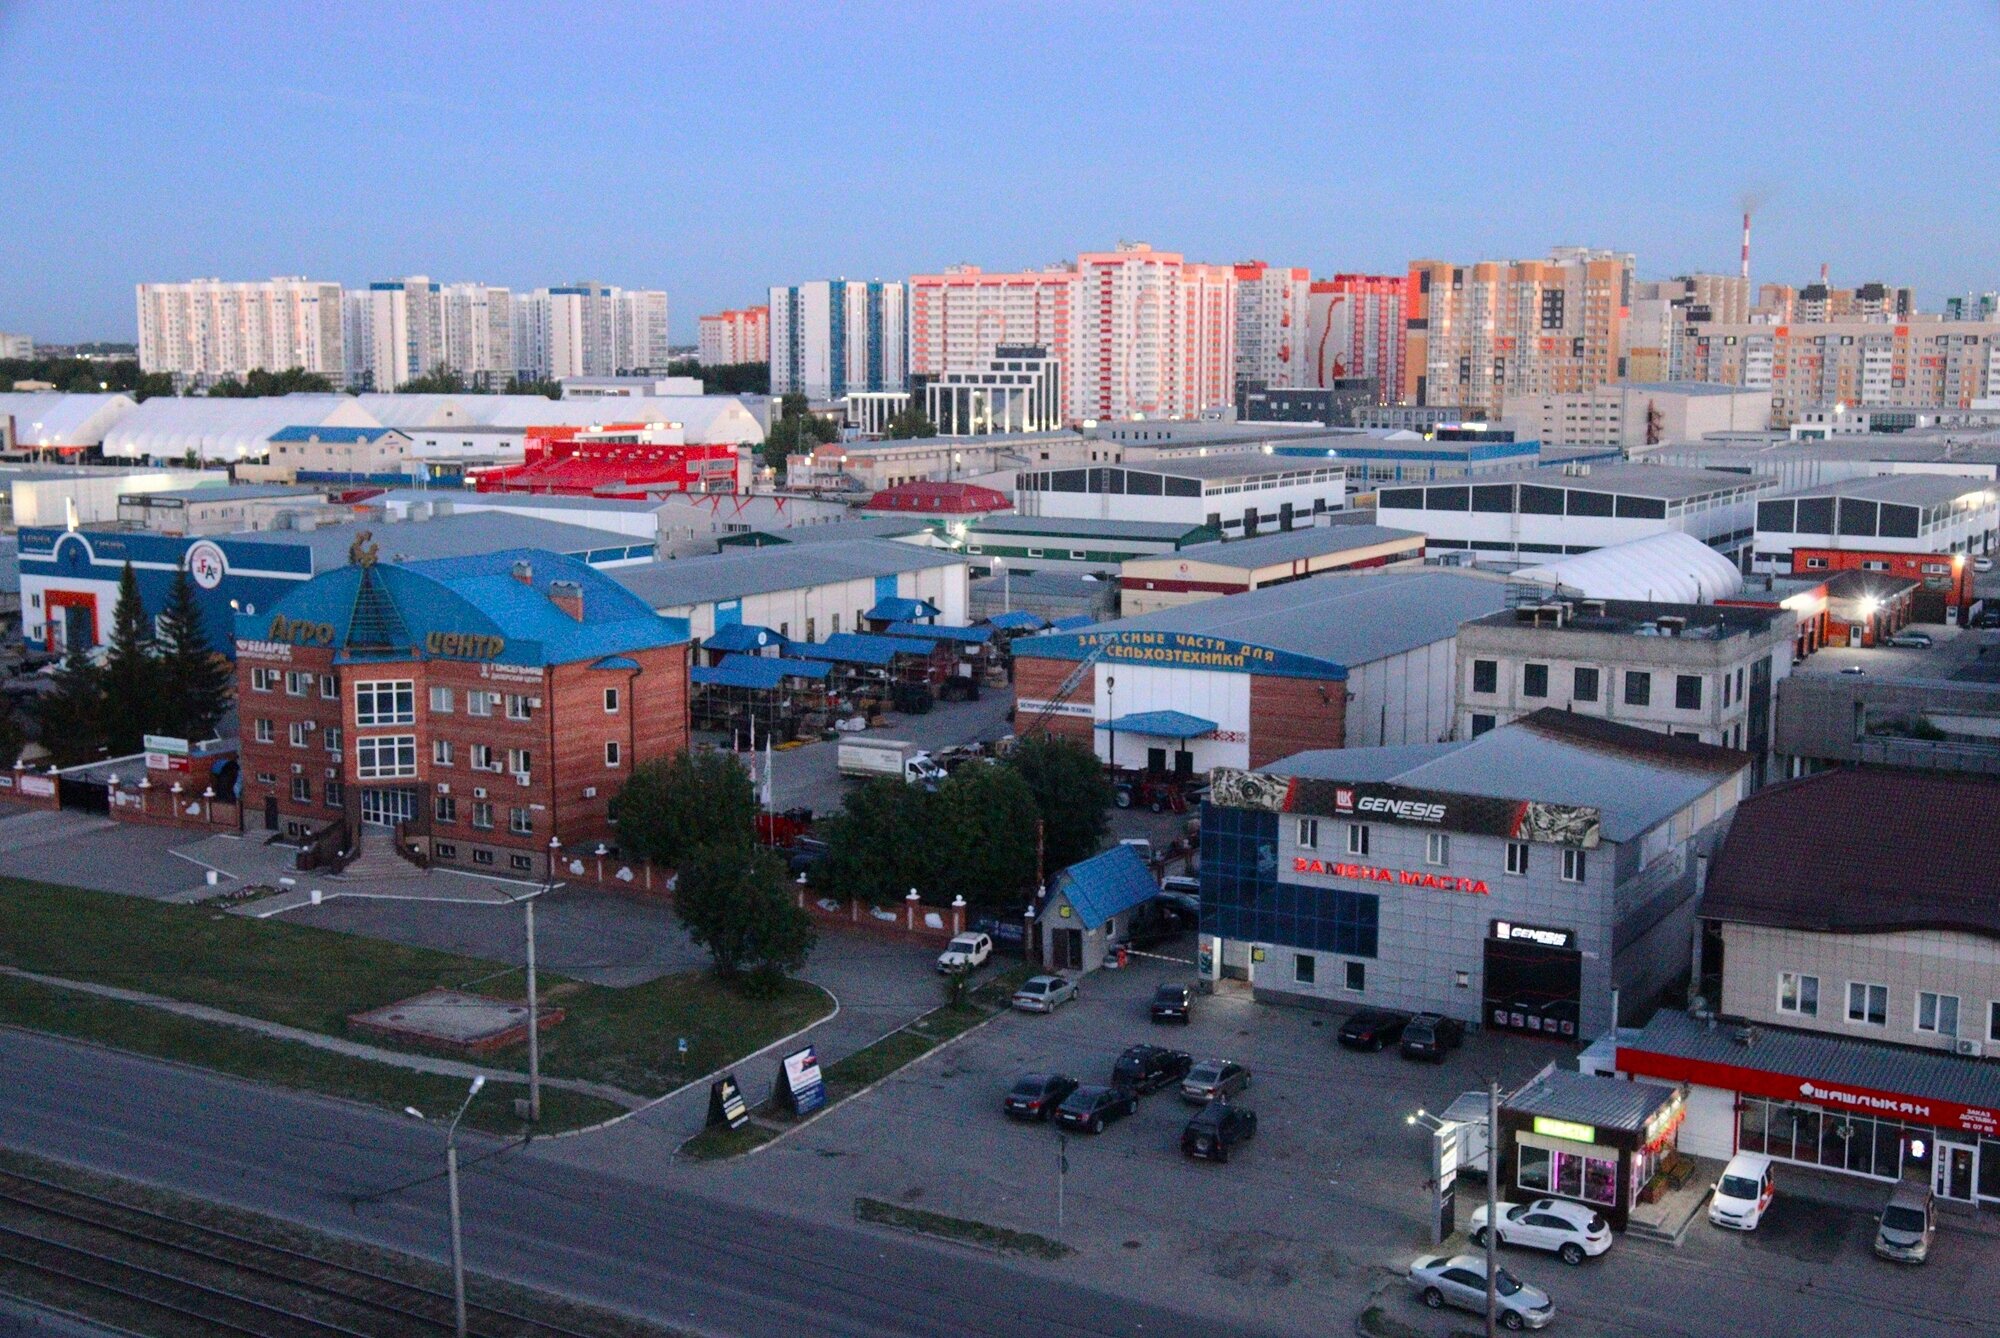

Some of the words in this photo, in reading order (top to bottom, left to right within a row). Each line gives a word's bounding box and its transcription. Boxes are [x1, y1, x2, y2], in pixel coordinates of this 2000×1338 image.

[268, 613, 335, 644] Агро
[1107, 645, 1245, 667] СЕЛЬХОЗТЕХНИКИ
[1176, 635, 1226, 651] ЧАСТИ
[1240, 645, 1275, 662] ДЛЯ
[1357, 796, 1447, 819] GENESIS
[1292, 857, 1394, 884] ЗАМЕНА
[1400, 870, 1490, 897] МАСЛА
[1511, 927, 1567, 943] GENESIS
[1958, 1113, 1998, 1125] ДОСТАВКА
